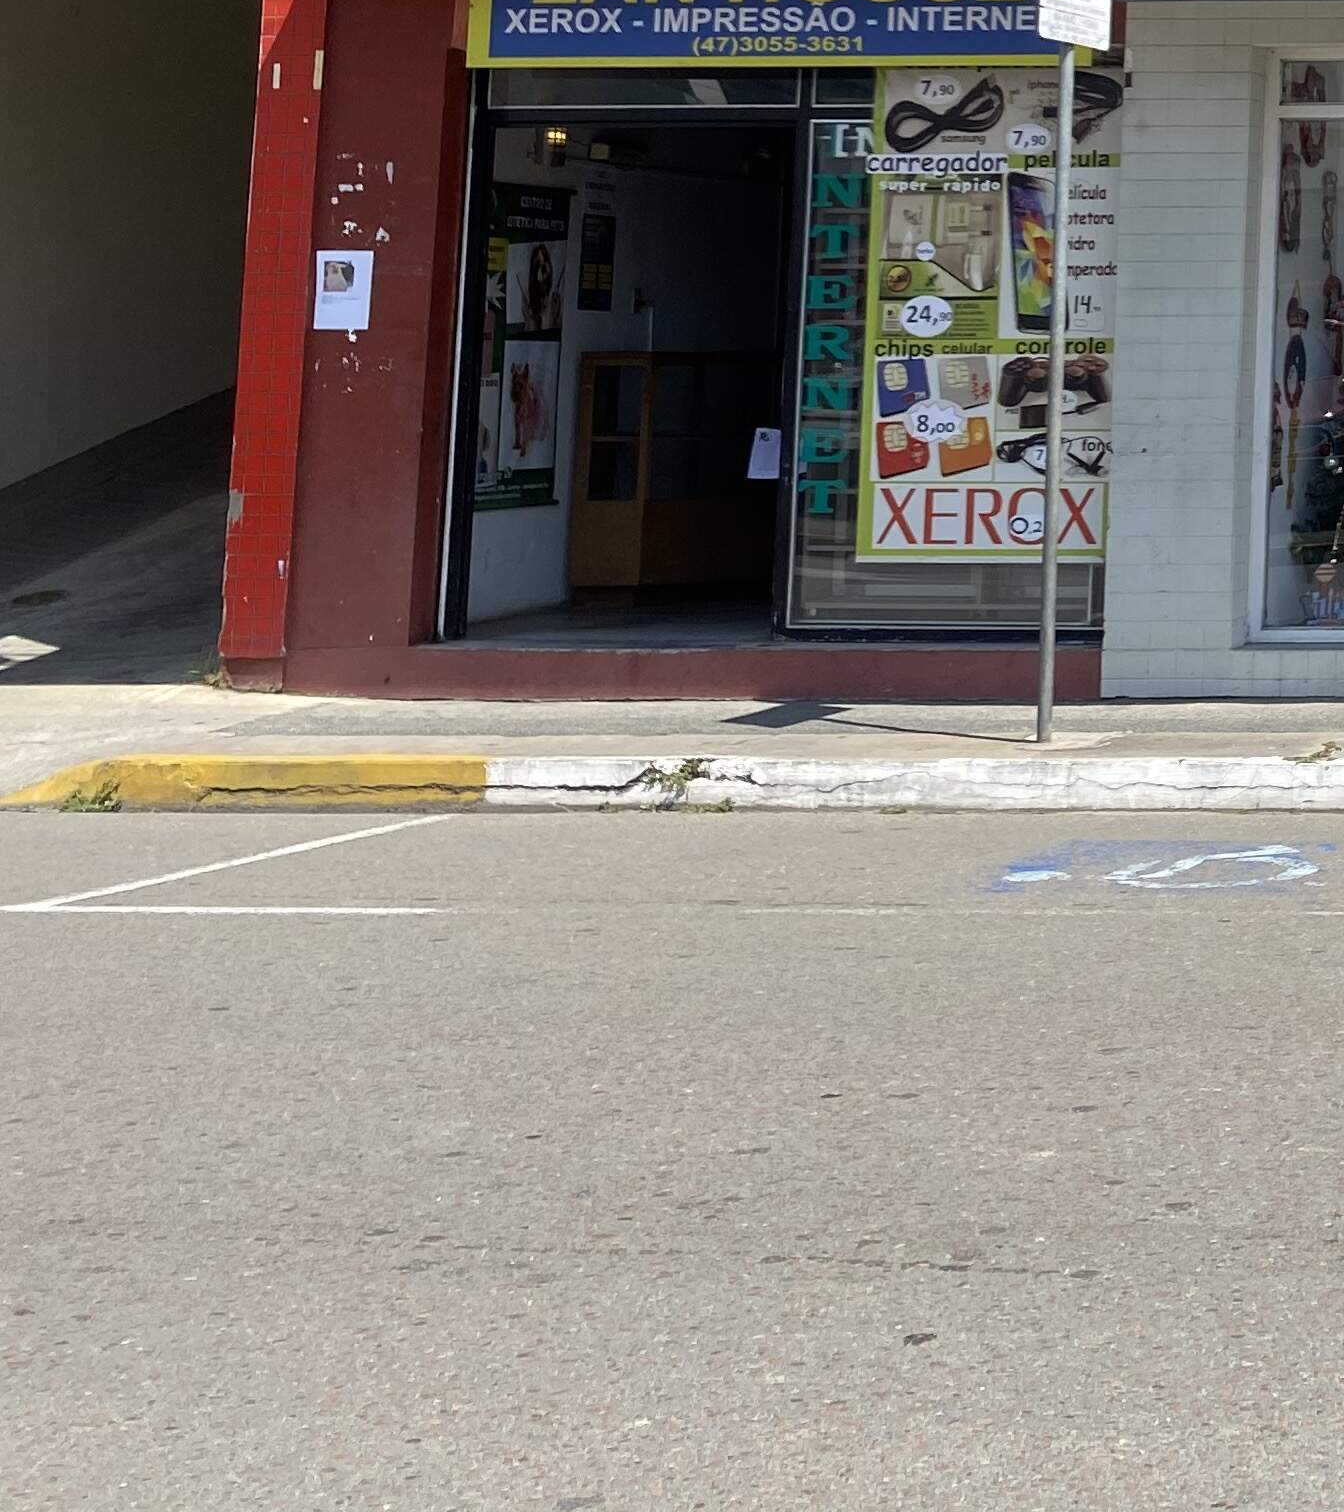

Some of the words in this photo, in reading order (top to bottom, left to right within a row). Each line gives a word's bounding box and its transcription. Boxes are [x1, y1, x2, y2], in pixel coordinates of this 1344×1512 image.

[504, 7, 623, 34] XEROX
[653, 2, 856, 34] IMPRESSÃO
[887, 5, 1039, 33] INTERNE
[692, 35, 864, 56] (47)3055-3631
[920, 79, 955, 97] 7,90
[1012, 129, 1047, 149] 7,90
[867, 150, 1008, 178] carregador
[1024, 149, 1110, 172] pelcula
[906, 304, 953, 326] 24,90
[875, 339, 934, 360] chips
[941, 341, 993, 355] celular
[1016, 337, 1107, 355] conrole
[916, 413, 956, 436] 8,00
[877, 487, 1097, 546] XEROX
